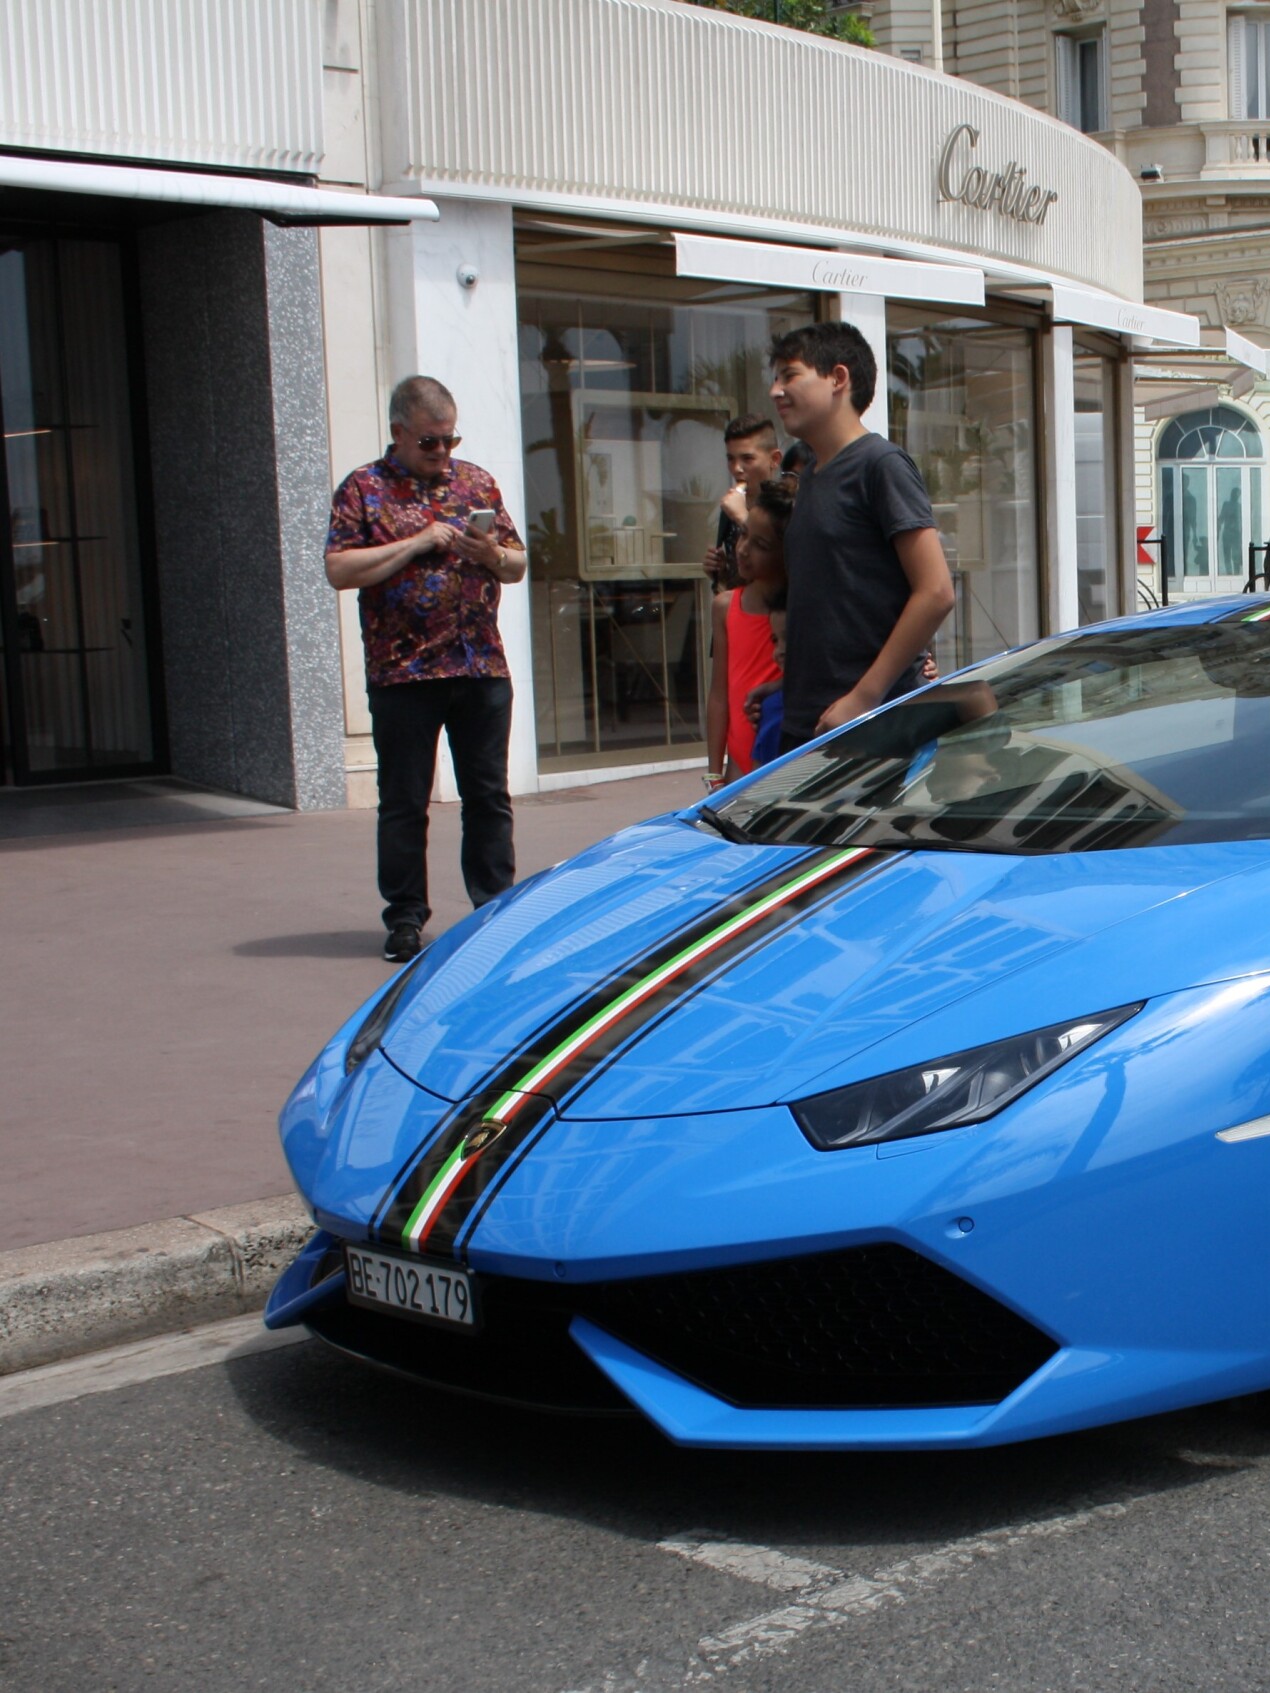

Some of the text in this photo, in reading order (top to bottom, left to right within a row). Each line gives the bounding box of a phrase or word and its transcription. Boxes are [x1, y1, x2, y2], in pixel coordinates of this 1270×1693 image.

[938, 124, 1058, 225] Cartier
[812, 260, 868, 287] Cartier
[1117, 307, 1145, 331] Cartier
